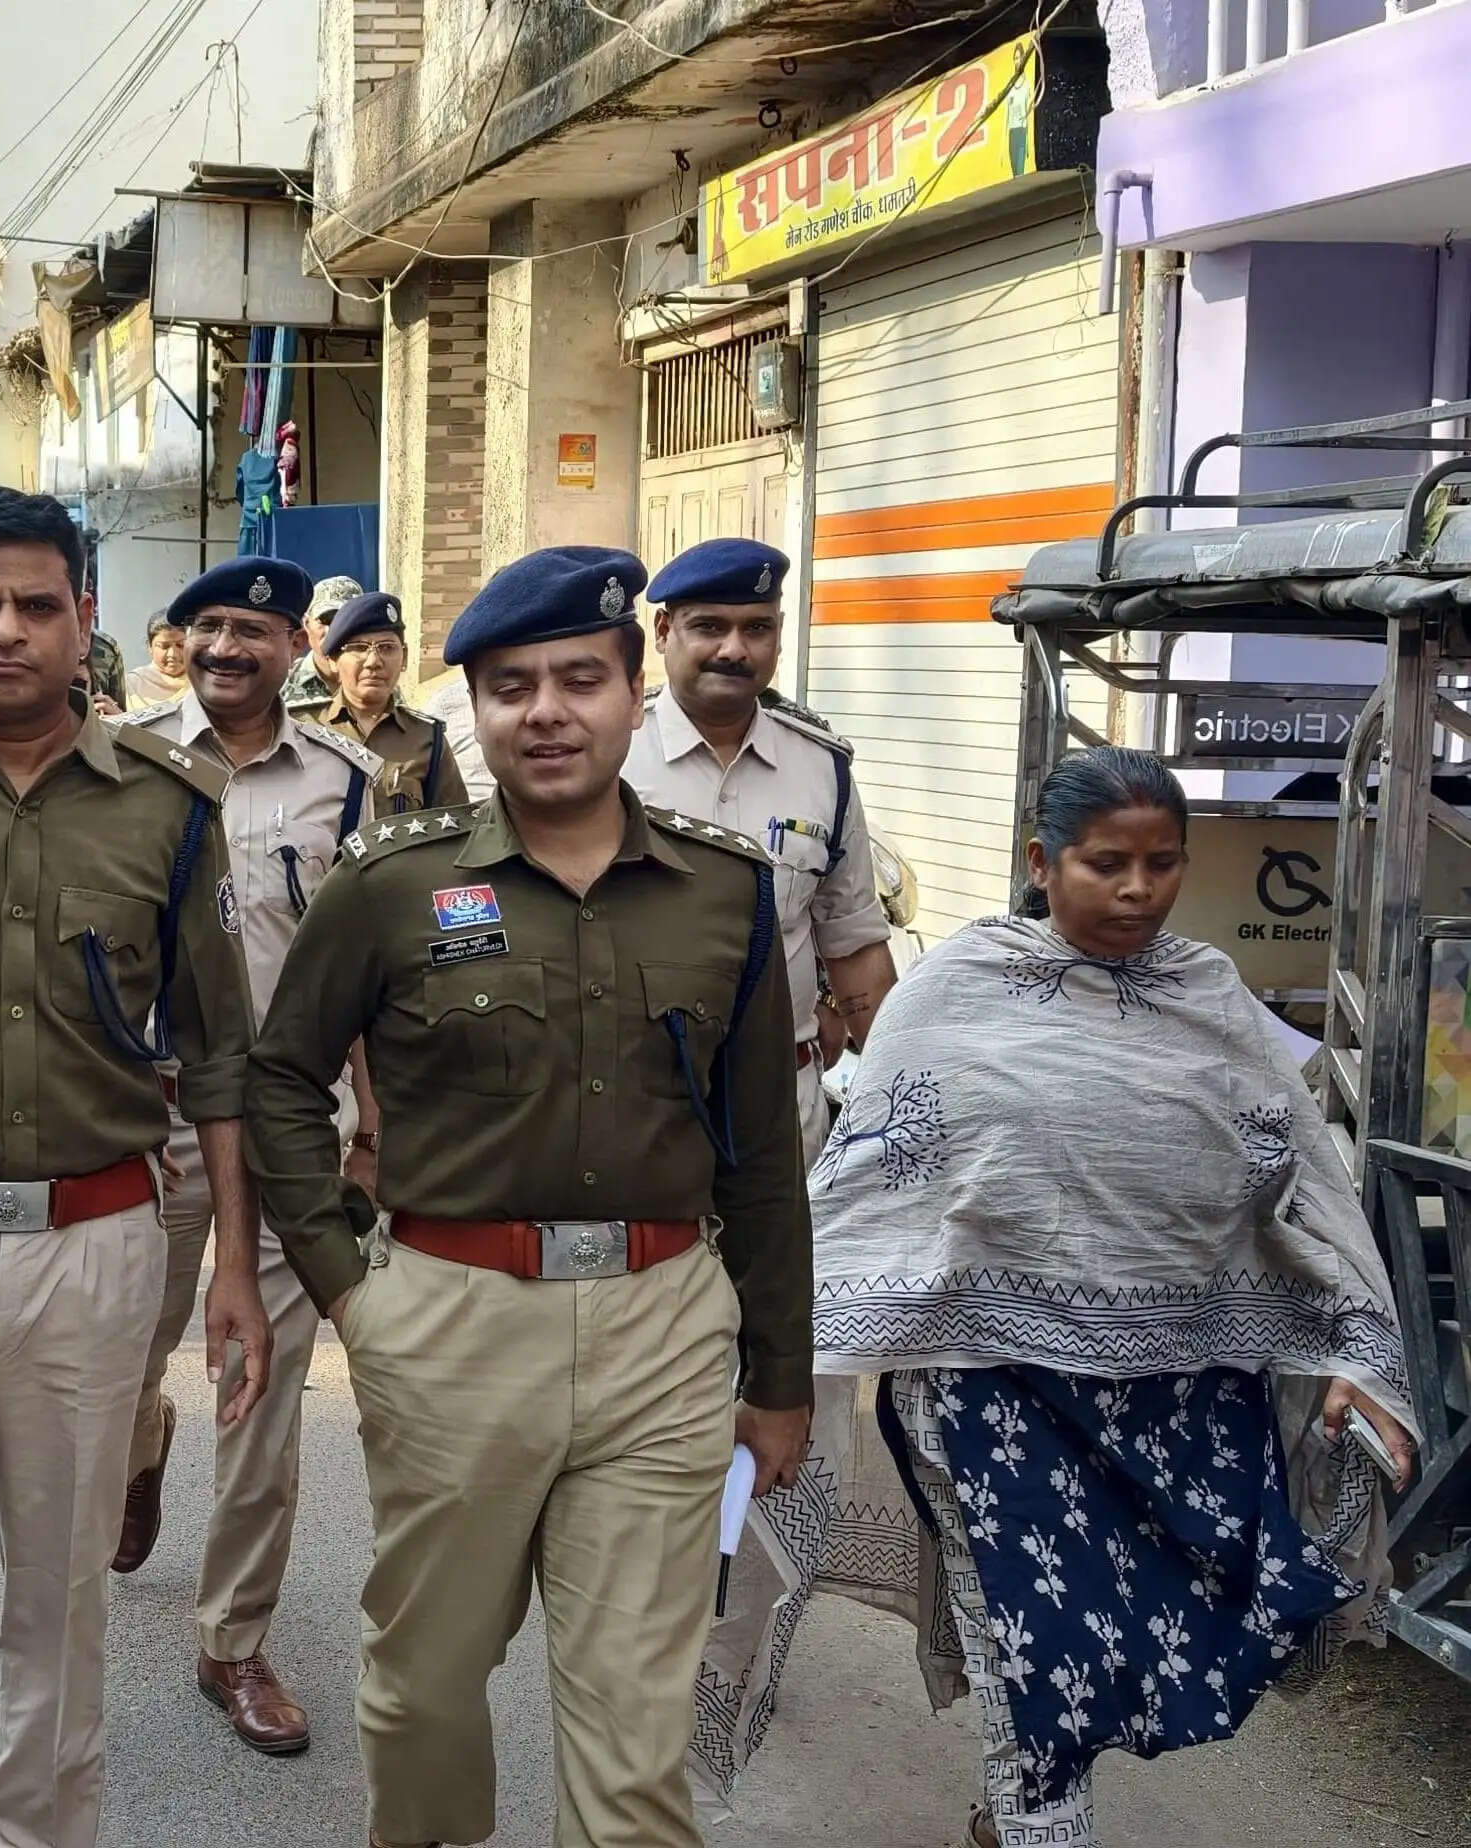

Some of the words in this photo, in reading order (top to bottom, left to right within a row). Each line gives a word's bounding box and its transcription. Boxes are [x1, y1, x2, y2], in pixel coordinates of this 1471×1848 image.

[734, 66, 986, 233] सपना-2
[785, 224, 802, 249] मेन
[821, 208, 849, 235] गणेश
[879, 176, 916, 215] धमतरी
[1237, 923, 1267, 941] GK
[1271, 924, 1332, 942] Electri
